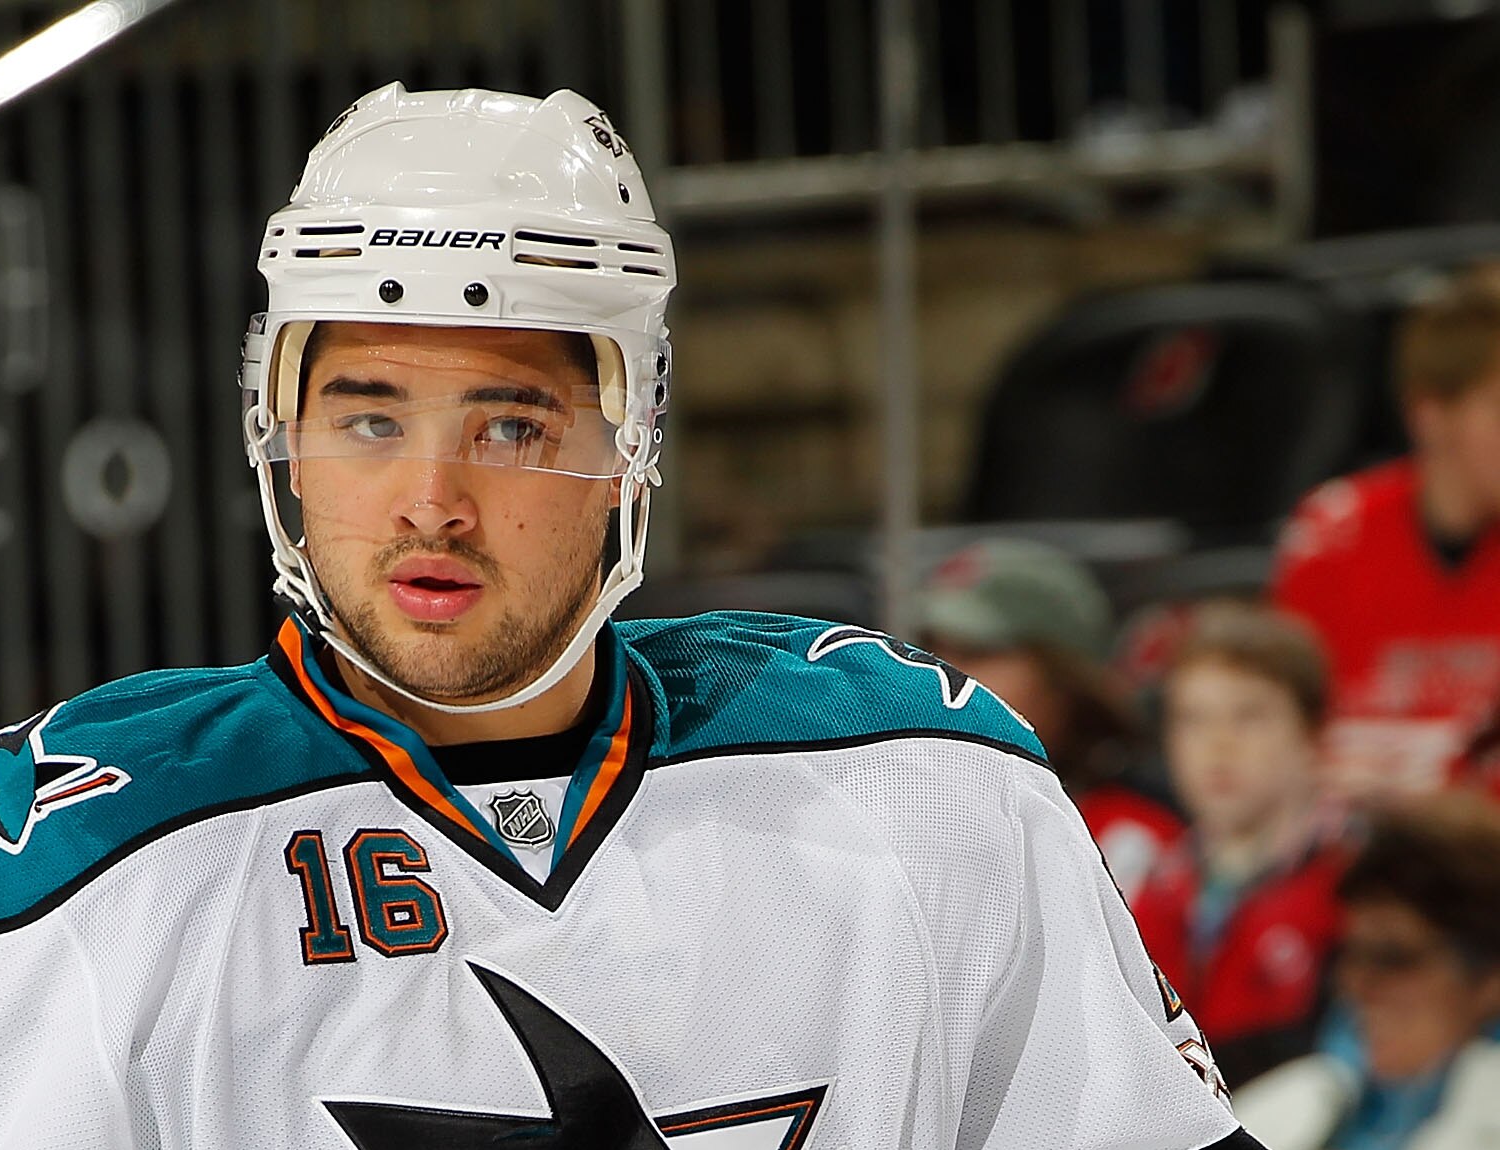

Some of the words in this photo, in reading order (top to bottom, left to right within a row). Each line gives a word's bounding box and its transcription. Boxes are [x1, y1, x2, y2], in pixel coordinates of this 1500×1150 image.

[368, 228, 506, 251] BAUER
[506, 800, 538, 838] NHL
[283, 827, 449, 967] 16
